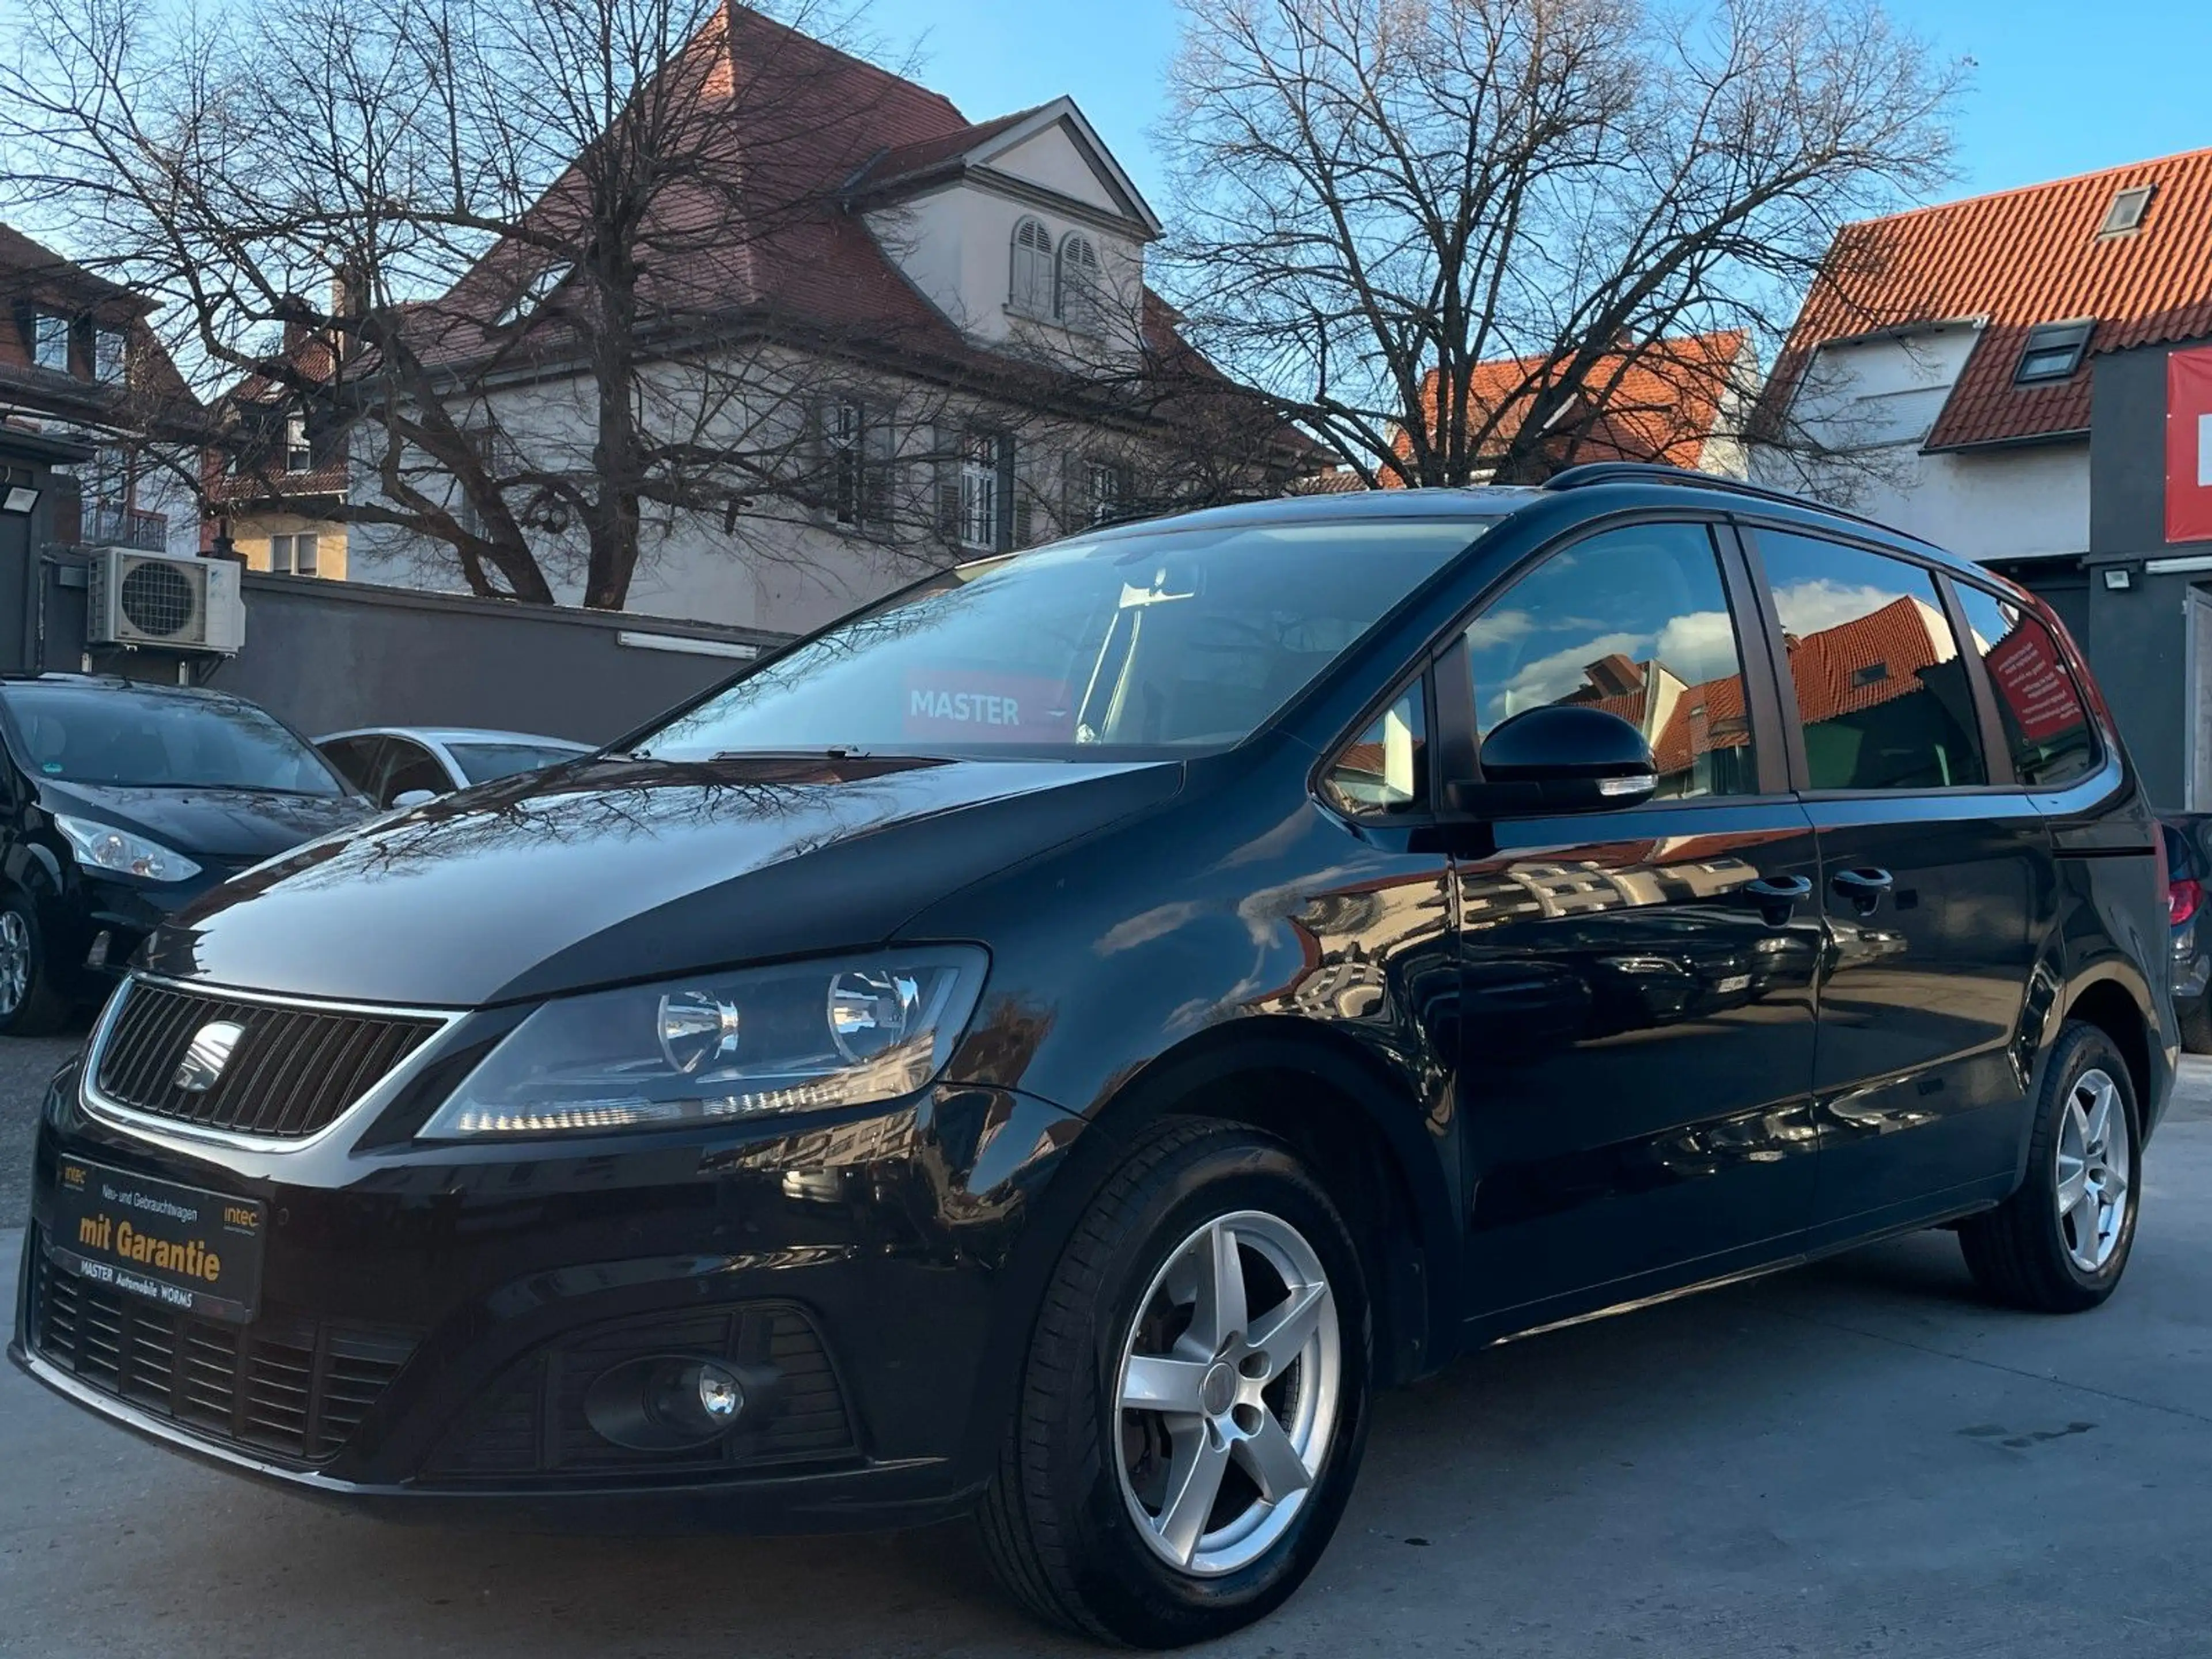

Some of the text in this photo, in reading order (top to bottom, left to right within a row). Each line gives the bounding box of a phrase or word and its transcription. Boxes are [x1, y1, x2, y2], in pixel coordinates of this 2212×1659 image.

[910, 690, 1020, 726] MASTER
[119, 1190, 132, 1205] und
[134, 1192, 198, 1223] Gebrauchtwagen
[79, 1214, 220, 1281] mit Garantie
[81, 1260, 193, 1308] MASTER Automobile WORMS
